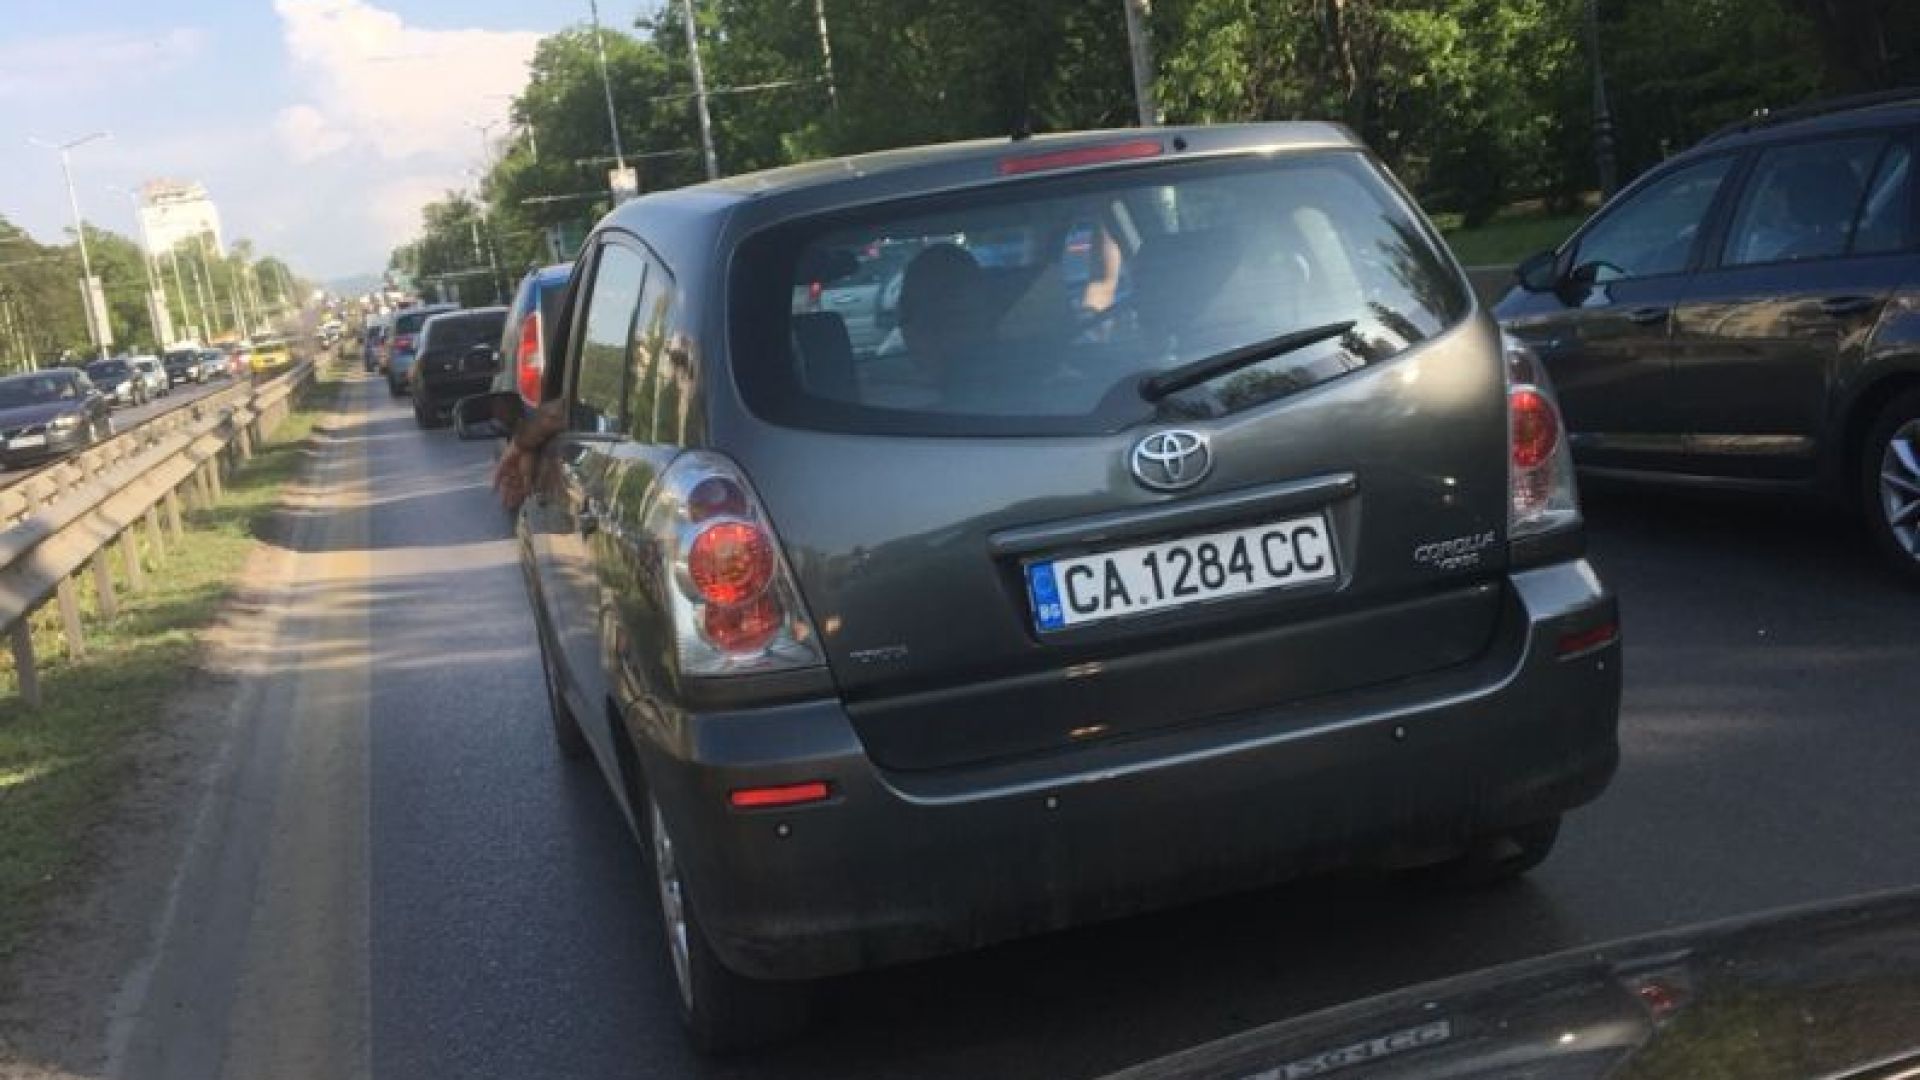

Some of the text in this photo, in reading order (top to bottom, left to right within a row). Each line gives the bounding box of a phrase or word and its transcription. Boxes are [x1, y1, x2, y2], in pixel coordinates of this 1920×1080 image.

[1065, 526, 1325, 614] CA 1284 CC
